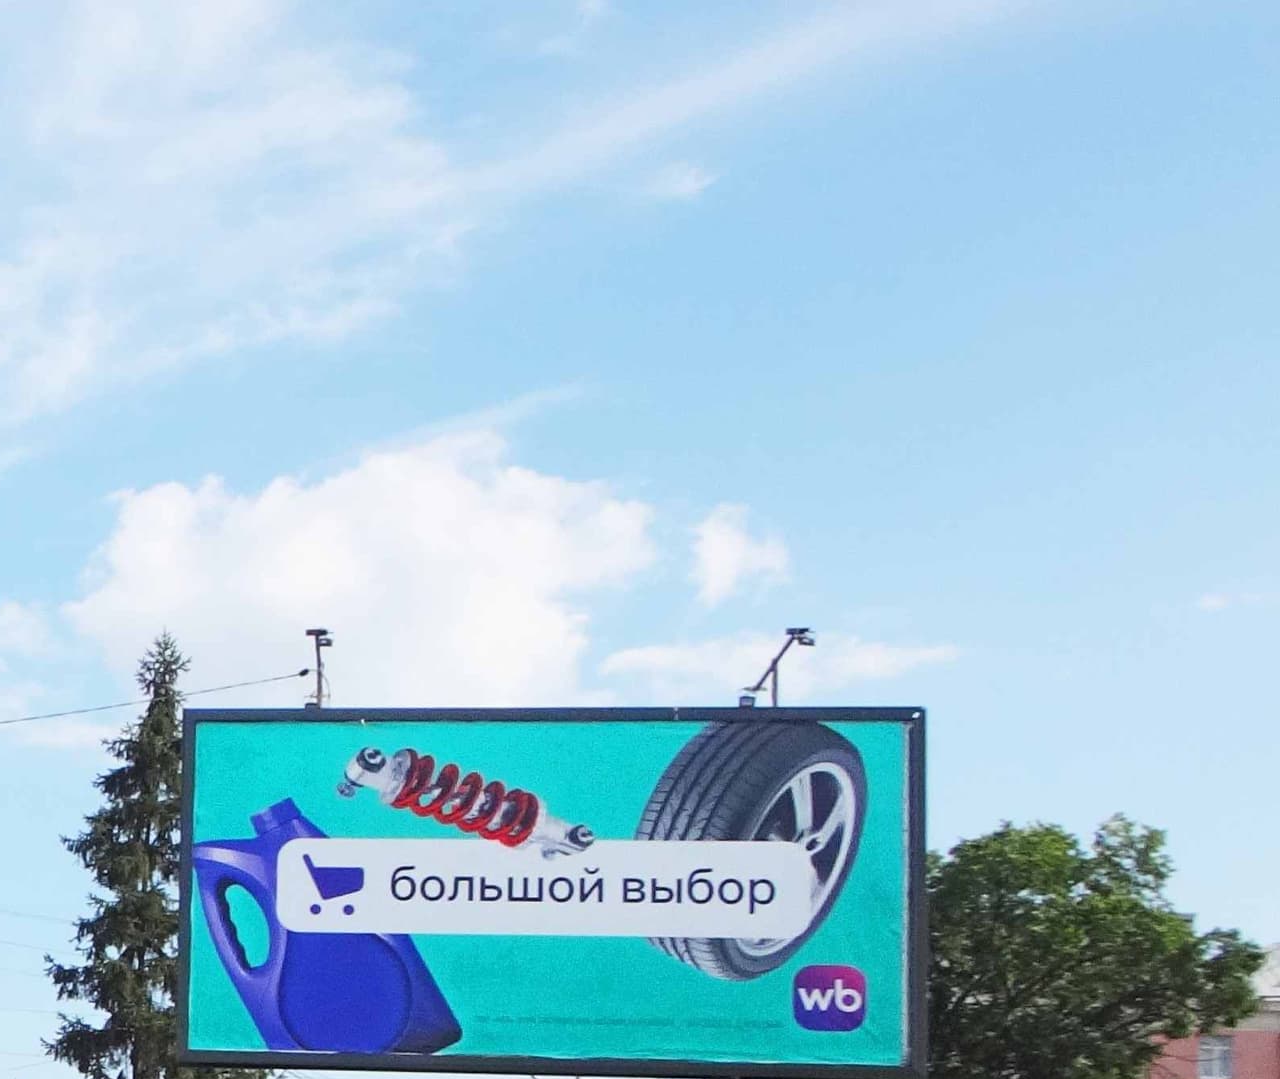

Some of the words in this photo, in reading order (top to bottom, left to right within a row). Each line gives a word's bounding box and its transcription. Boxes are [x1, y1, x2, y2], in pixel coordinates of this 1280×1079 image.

[389, 865, 603, 905] большой
[621, 868, 776, 914] выбор
[797, 979, 862, 1013] wb
